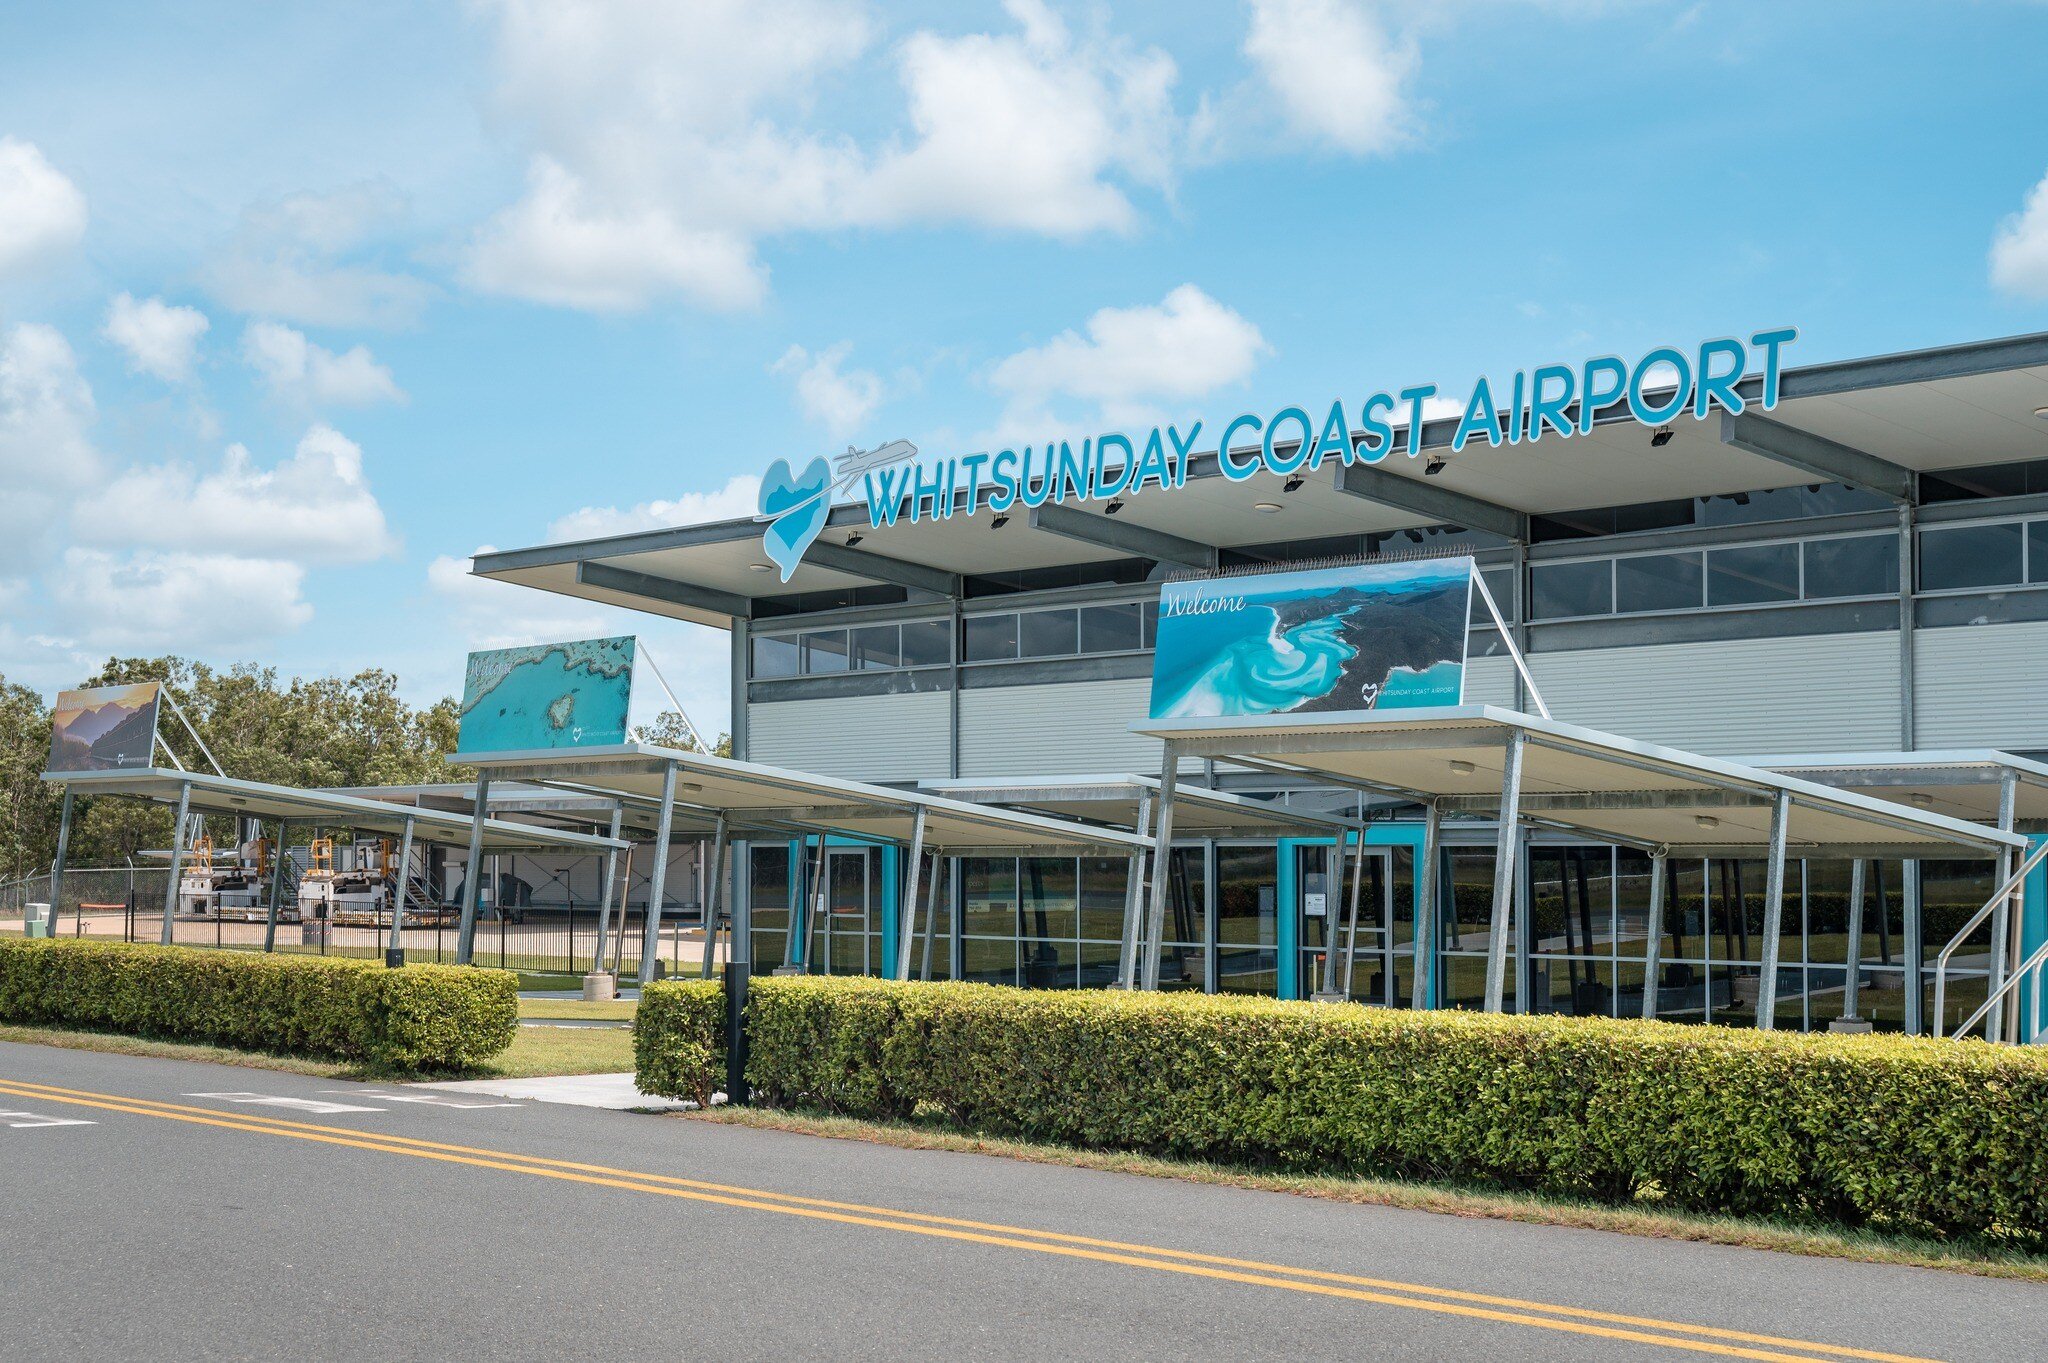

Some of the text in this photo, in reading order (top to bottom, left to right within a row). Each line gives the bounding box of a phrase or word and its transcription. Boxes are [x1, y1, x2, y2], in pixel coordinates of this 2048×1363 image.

[863, 324, 1800, 529] WHITSUNDAY COAST AIRPORT
[1166, 586, 1247, 617] Welcome
